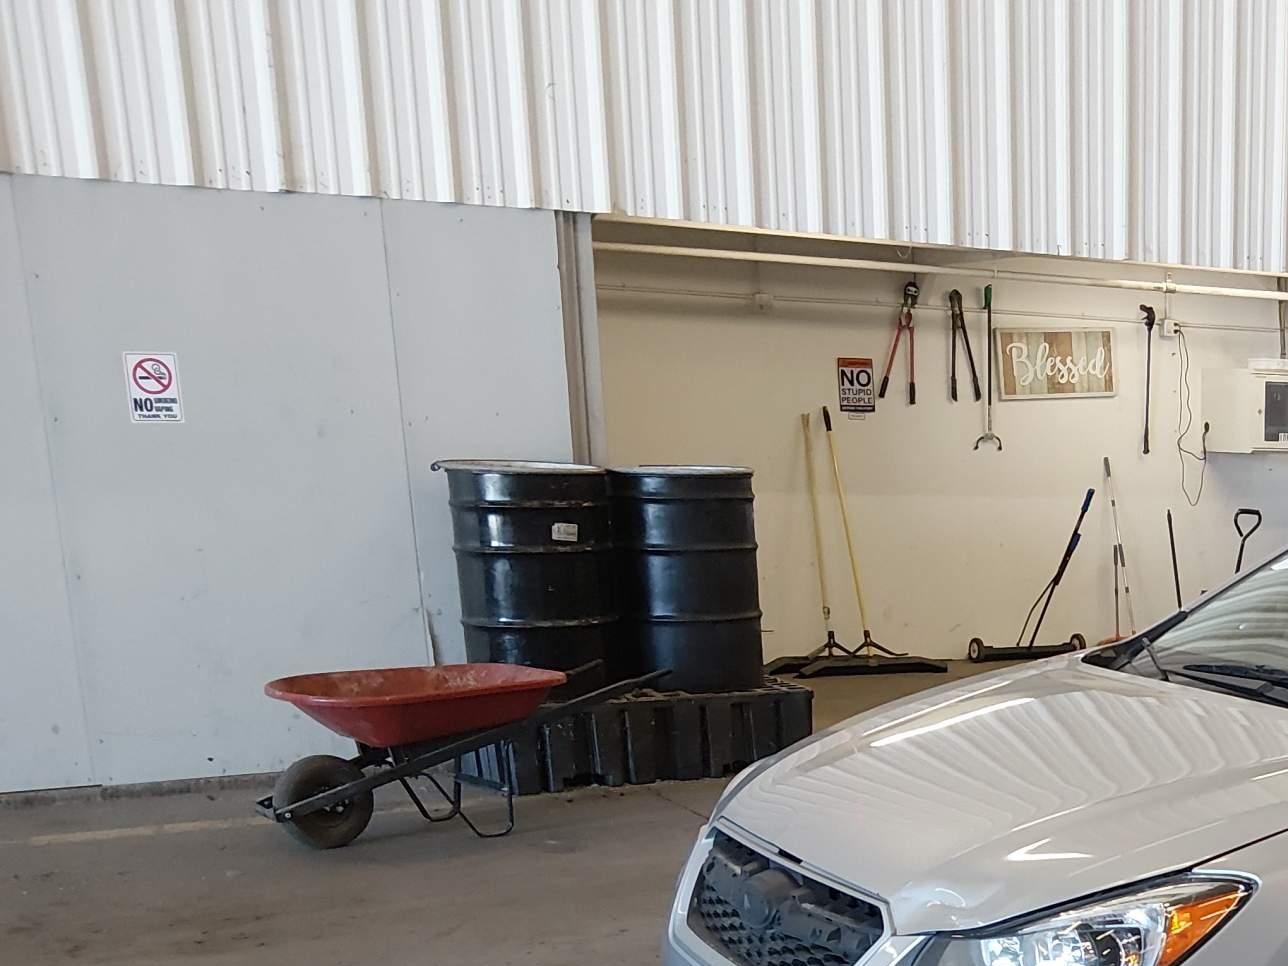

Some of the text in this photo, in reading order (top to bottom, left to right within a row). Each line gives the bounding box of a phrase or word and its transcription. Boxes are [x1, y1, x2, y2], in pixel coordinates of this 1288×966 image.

[1006, 342, 1109, 386] Blessed
[840, 369, 871, 387] NO
[841, 388, 872, 396] STUPID
[133, 398, 153, 412] NO
